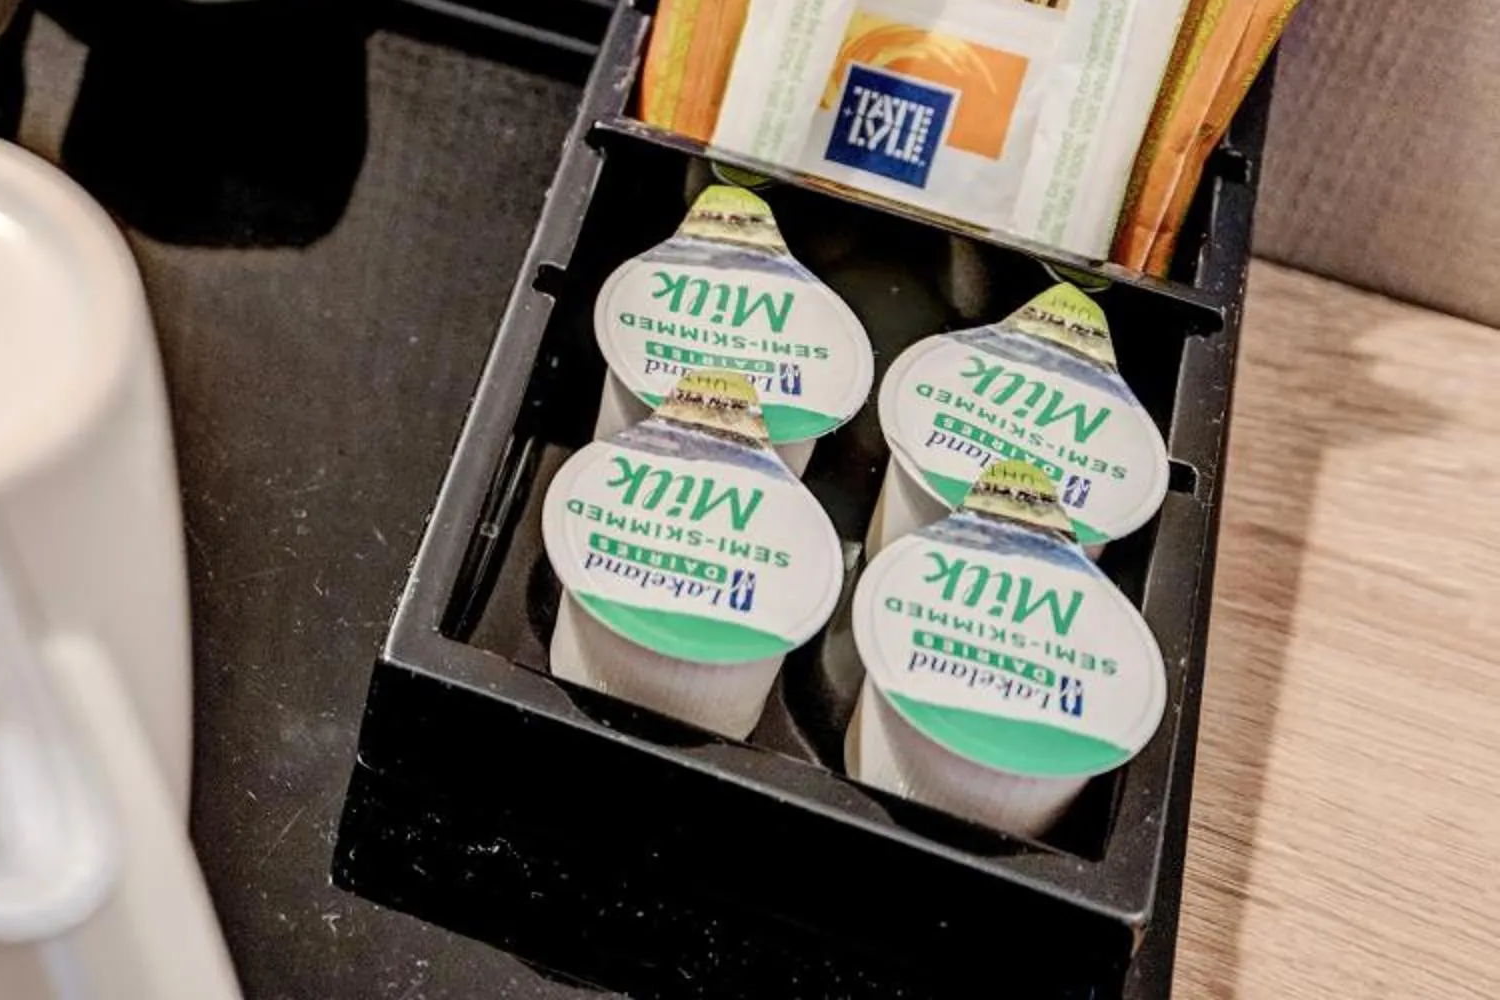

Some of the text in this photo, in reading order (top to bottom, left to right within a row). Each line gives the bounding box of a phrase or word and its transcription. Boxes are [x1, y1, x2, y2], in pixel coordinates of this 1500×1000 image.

[853, 85, 935, 132] TATE
[847, 115, 927, 164] LYLE
[652, 270, 795, 333] Milk
[620, 311, 828, 359] SEMI-SKIMMED
[649, 342, 767, 371] DAIRIES
[959, 355, 1111, 444] Milk
[916, 383, 1127, 480] SEMI-SKIMMED
[941, 416, 1056, 475] DAIRIES
[607, 456, 764, 532] Milk
[567, 499, 791, 568] SEMI-SKIMMED
[597, 535, 720, 579] DAIRIES
[584, 552, 728, 605] Lakeland
[922, 551, 1085, 636] Milk
[885, 597, 1118, 676] SEMI-SKIMMED
[922, 632, 1047, 682] DAIRIES
[908, 650, 1051, 709] Lakeland
